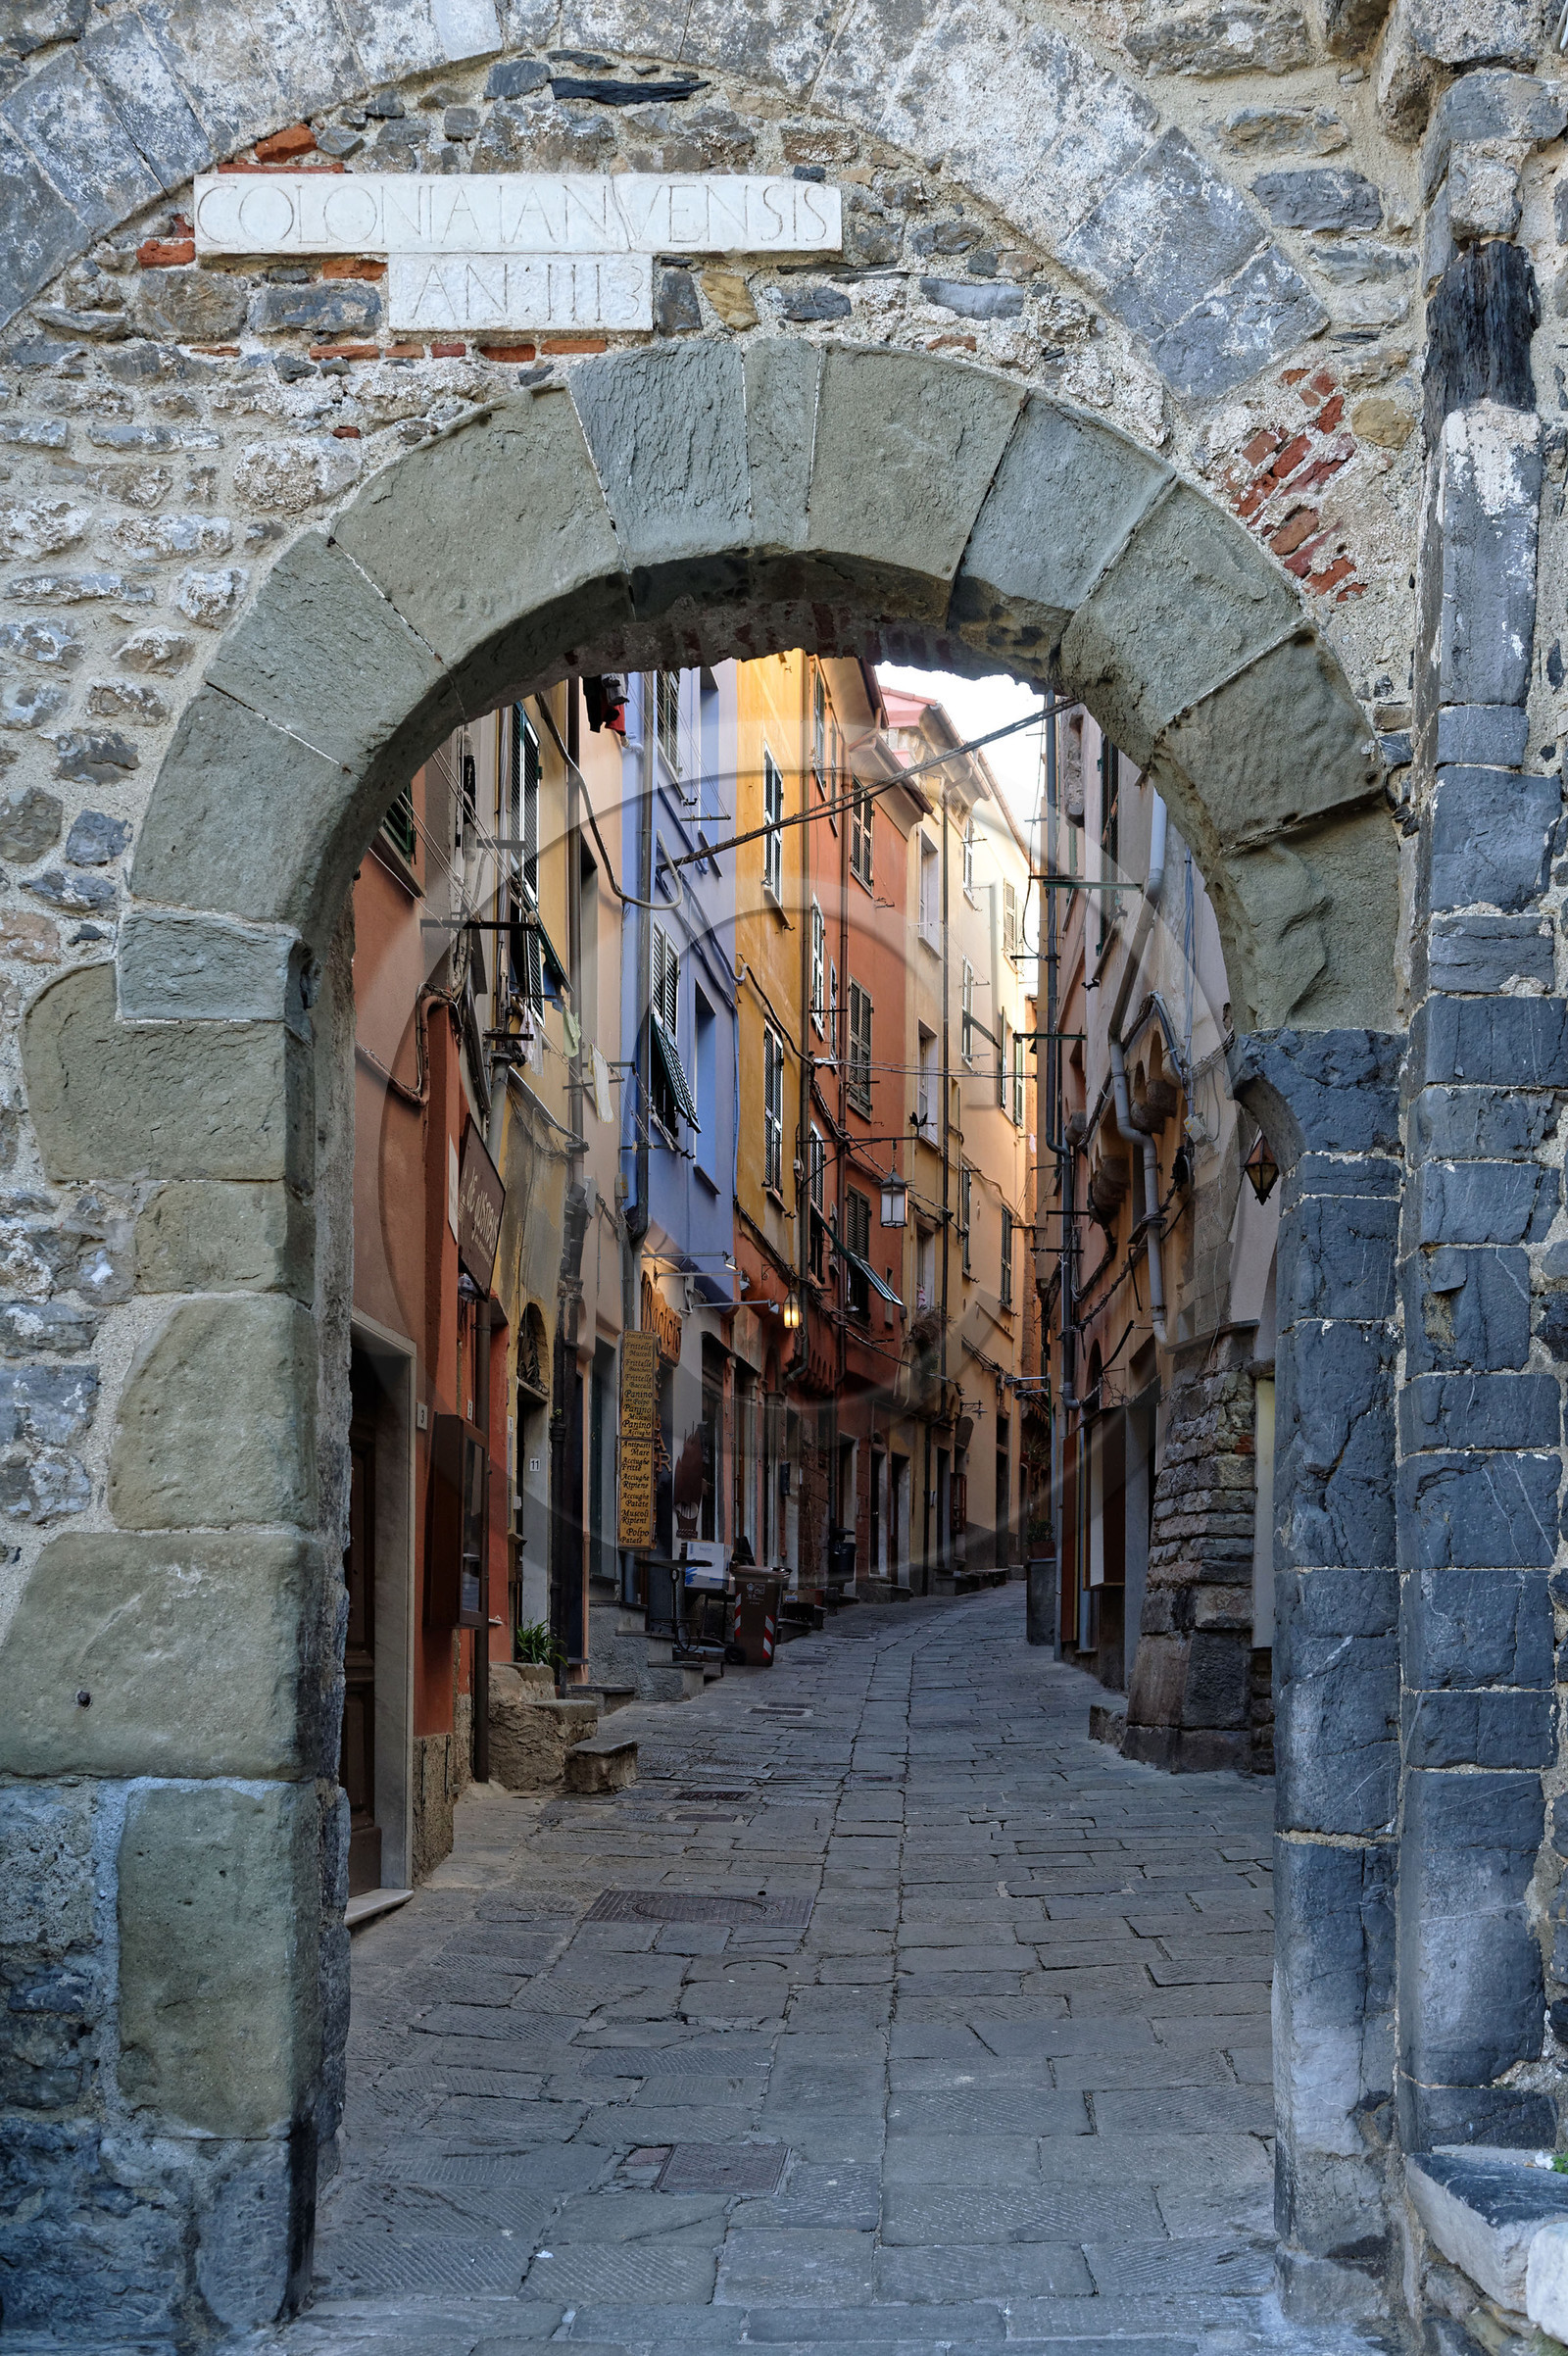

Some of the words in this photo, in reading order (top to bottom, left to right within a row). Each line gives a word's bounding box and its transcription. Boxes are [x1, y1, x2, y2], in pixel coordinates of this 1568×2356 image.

[623, 1389, 653, 1399] Panino
[622, 1403, 652, 1413] Panino
[621, 1420, 652, 1429] Panino
[531, 1460, 539, 1470] 11
[620, 1509, 649, 1518] Muscoli
[625, 1527, 650, 1538] Polpo
